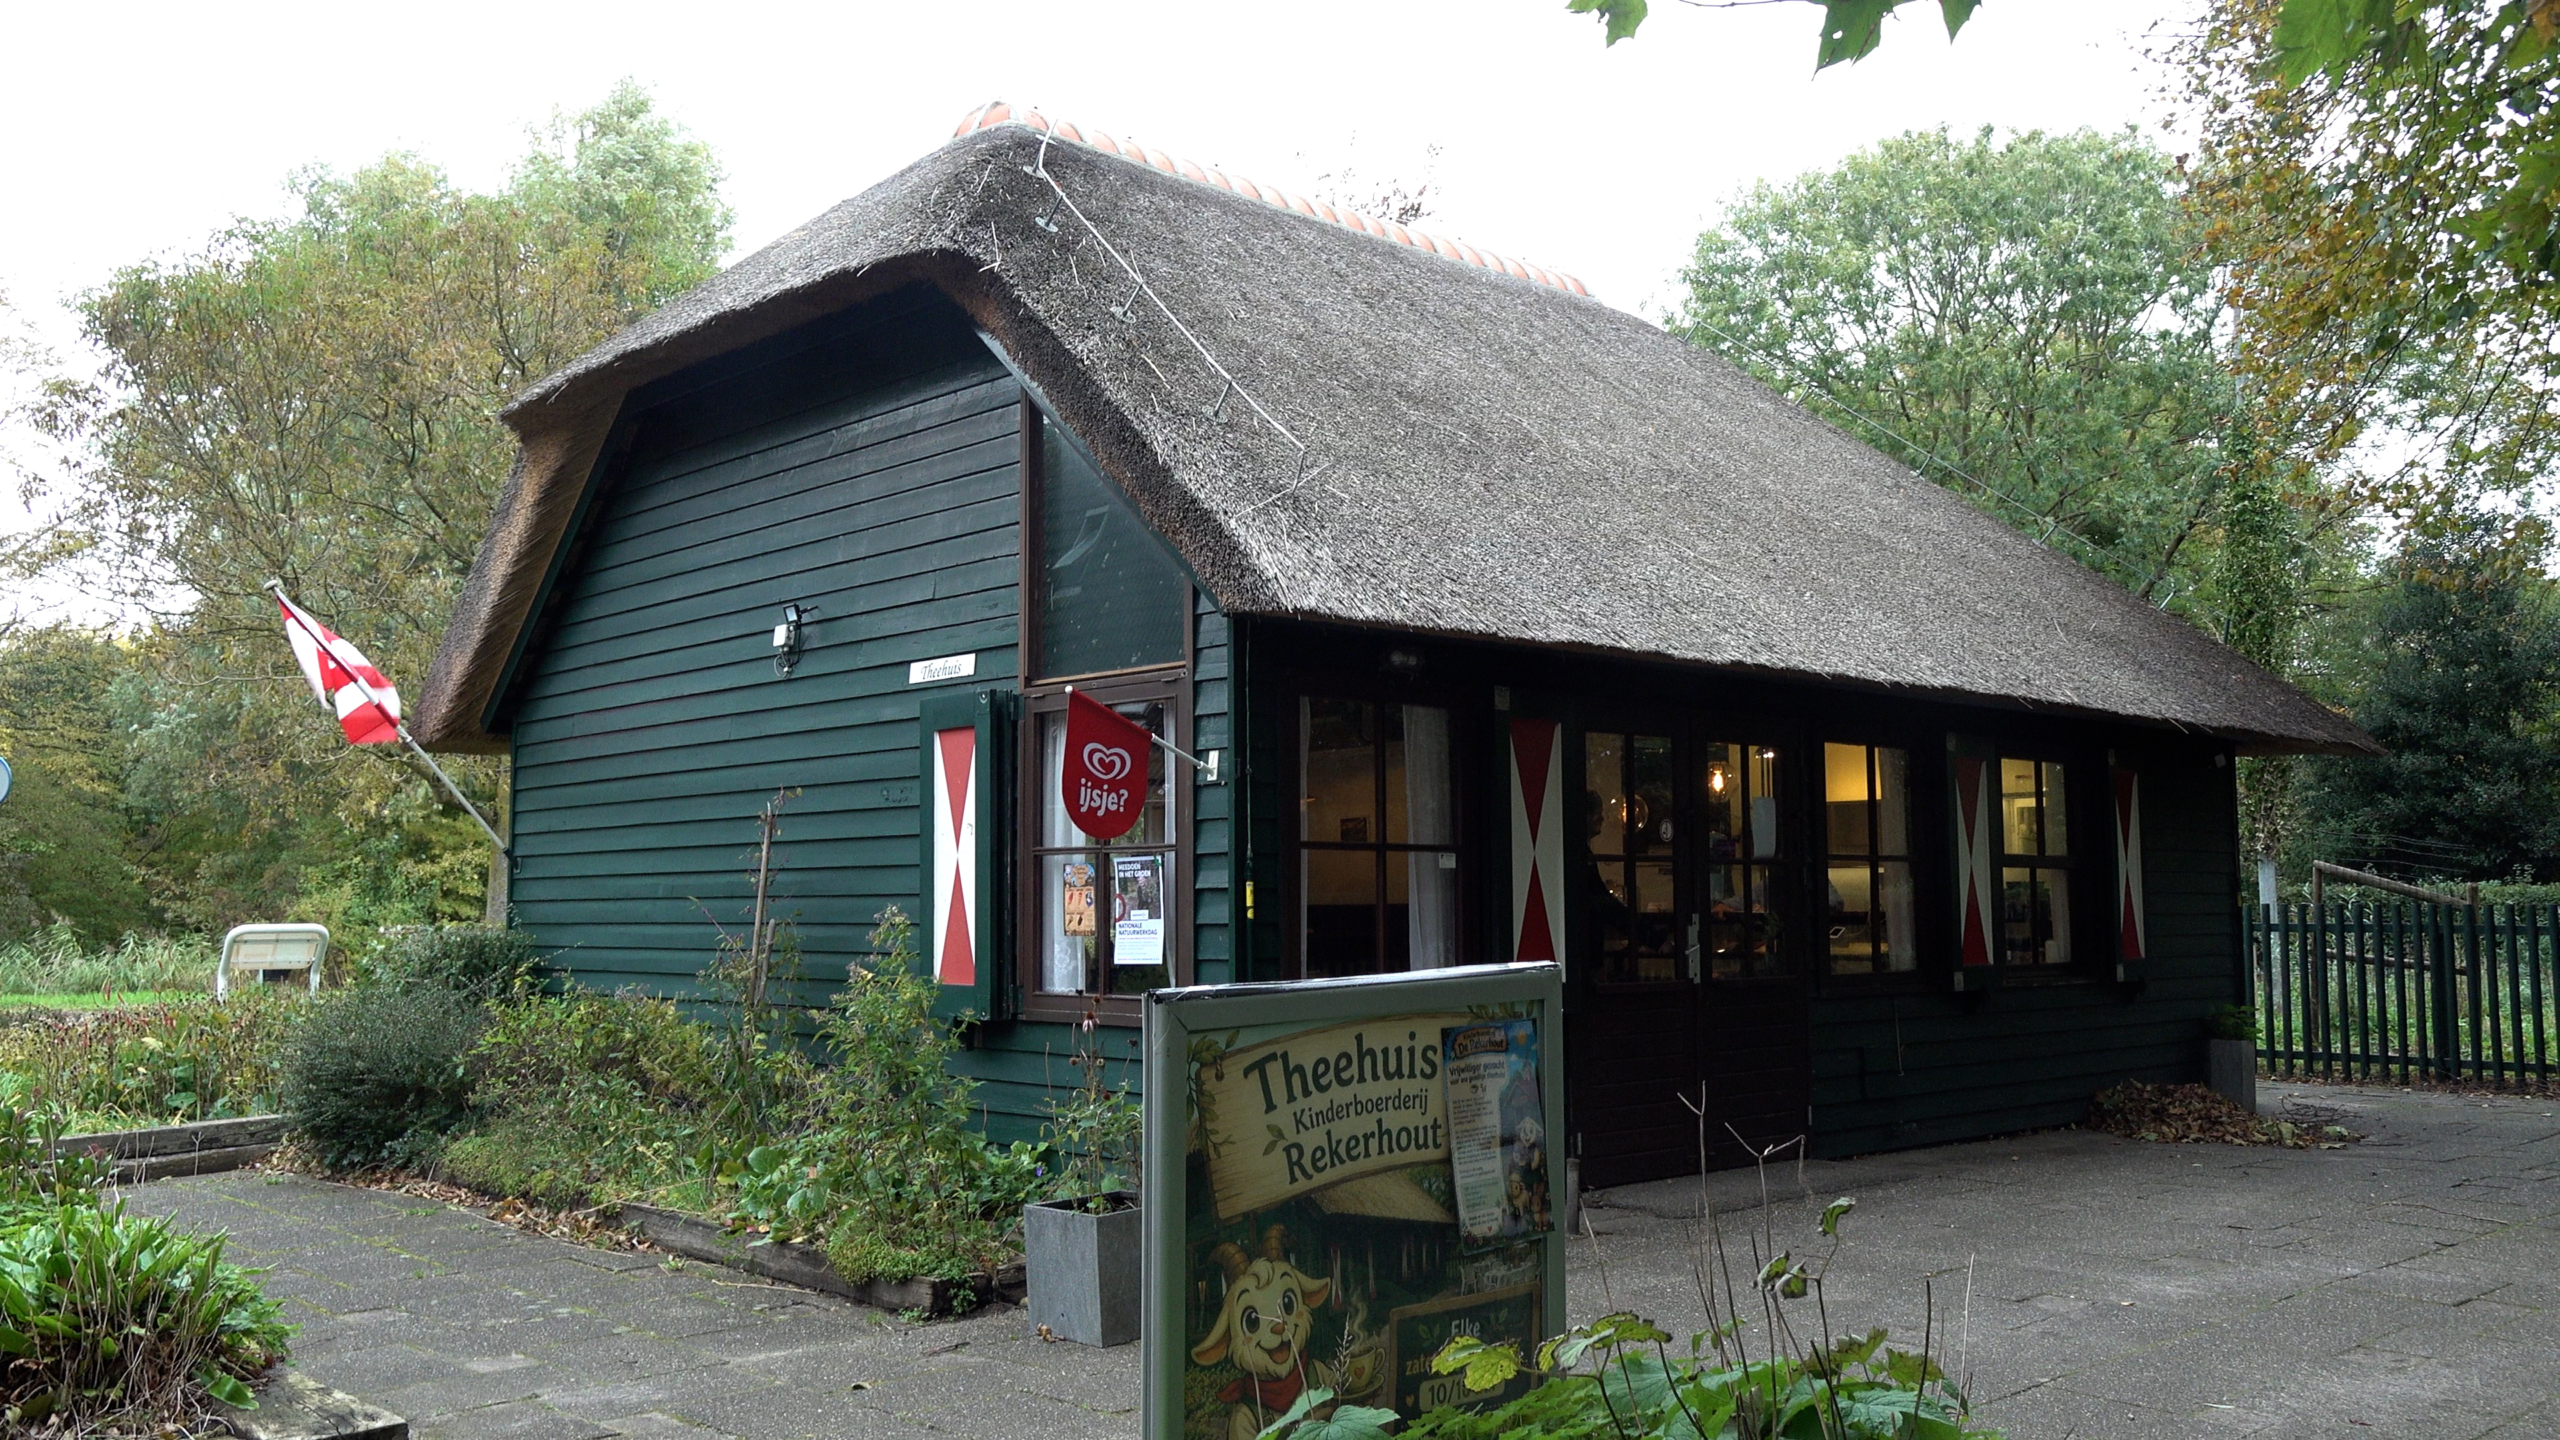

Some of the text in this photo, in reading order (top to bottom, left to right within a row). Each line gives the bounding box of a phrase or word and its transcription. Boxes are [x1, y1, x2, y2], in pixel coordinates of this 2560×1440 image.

[920, 659, 962, 680] Theehuis
[1079, 777, 1129, 817] ijsje?
[1118, 863, 1141, 871] MEEDOEN
[1134, 870, 1151, 878] GROEN
[1458, 1043, 1468, 1055] De
[1243, 1030, 1438, 1115] Theehuis
[1292, 1088, 1428, 1135] Kinderboerderij
[1282, 1116, 1443, 1185] Rekerhout
[1451, 1317, 1481, 1338] Elke
